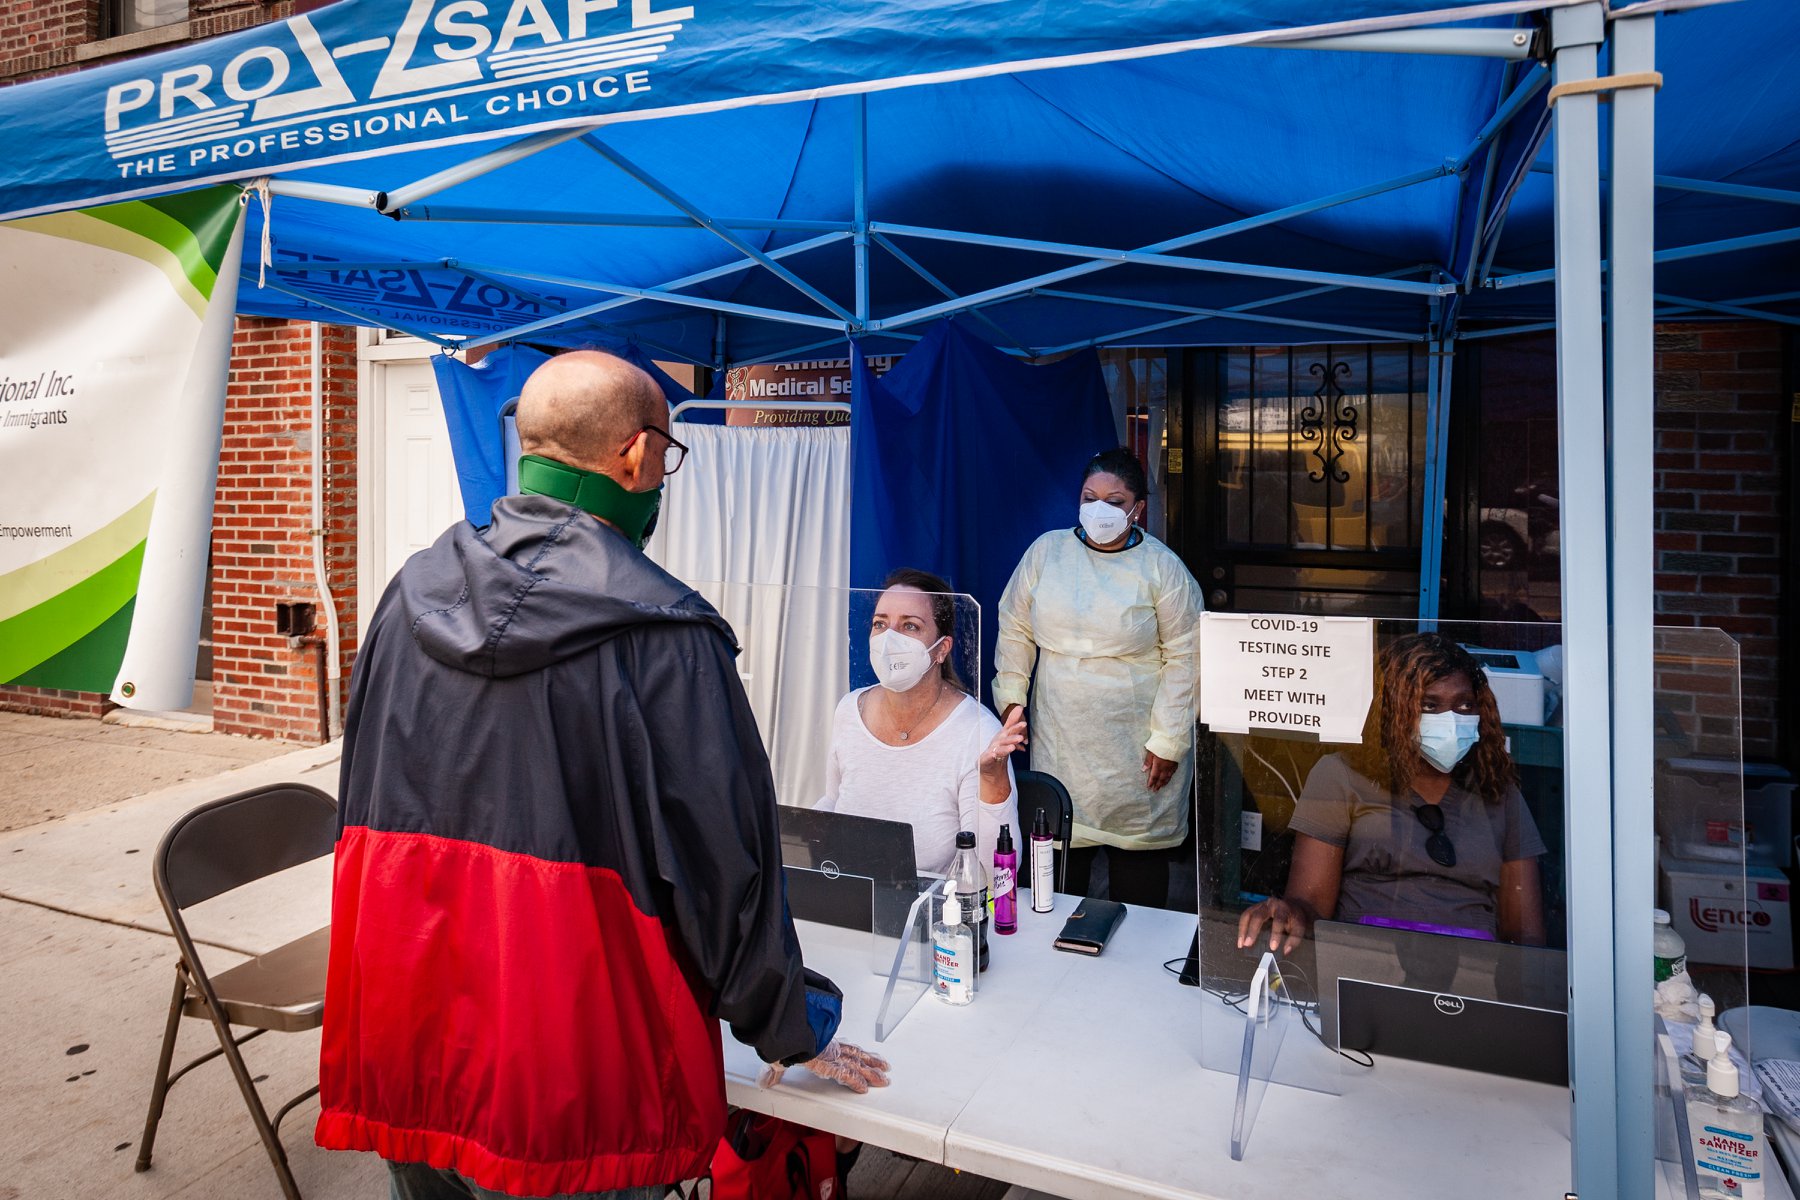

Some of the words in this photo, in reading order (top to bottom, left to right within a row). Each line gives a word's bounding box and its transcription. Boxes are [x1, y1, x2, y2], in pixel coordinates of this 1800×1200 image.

[117, 154, 176, 179] THE
[190, 103, 469, 166] PROFESSIONAL
[485, 70, 652, 116] CHOICE
[0, 372, 45, 402] ional
[45, 370, 75, 398] Inc.
[750, 376, 824, 397] Medical
[3, 409, 68, 429] Immigrants
[753, 410, 820, 425] Providing
[1250, 618, 1319, 633] COVID-19
[1239, 641, 1298, 656] TESTING
[1301, 645, 1331, 658] SITE
[1261, 666, 1295, 679] STEP
[1299, 668, 1308, 680] 2
[1244, 689, 1284, 702] MEET
[1287, 691, 1326, 706] WITH
[1249, 710, 1321, 728] PROVIDER
[1437, 999, 1462, 1009] DELL
[1699, 1138, 1759, 1157] SANITIZER
[1713, 1136, 1746, 1150] HAND
